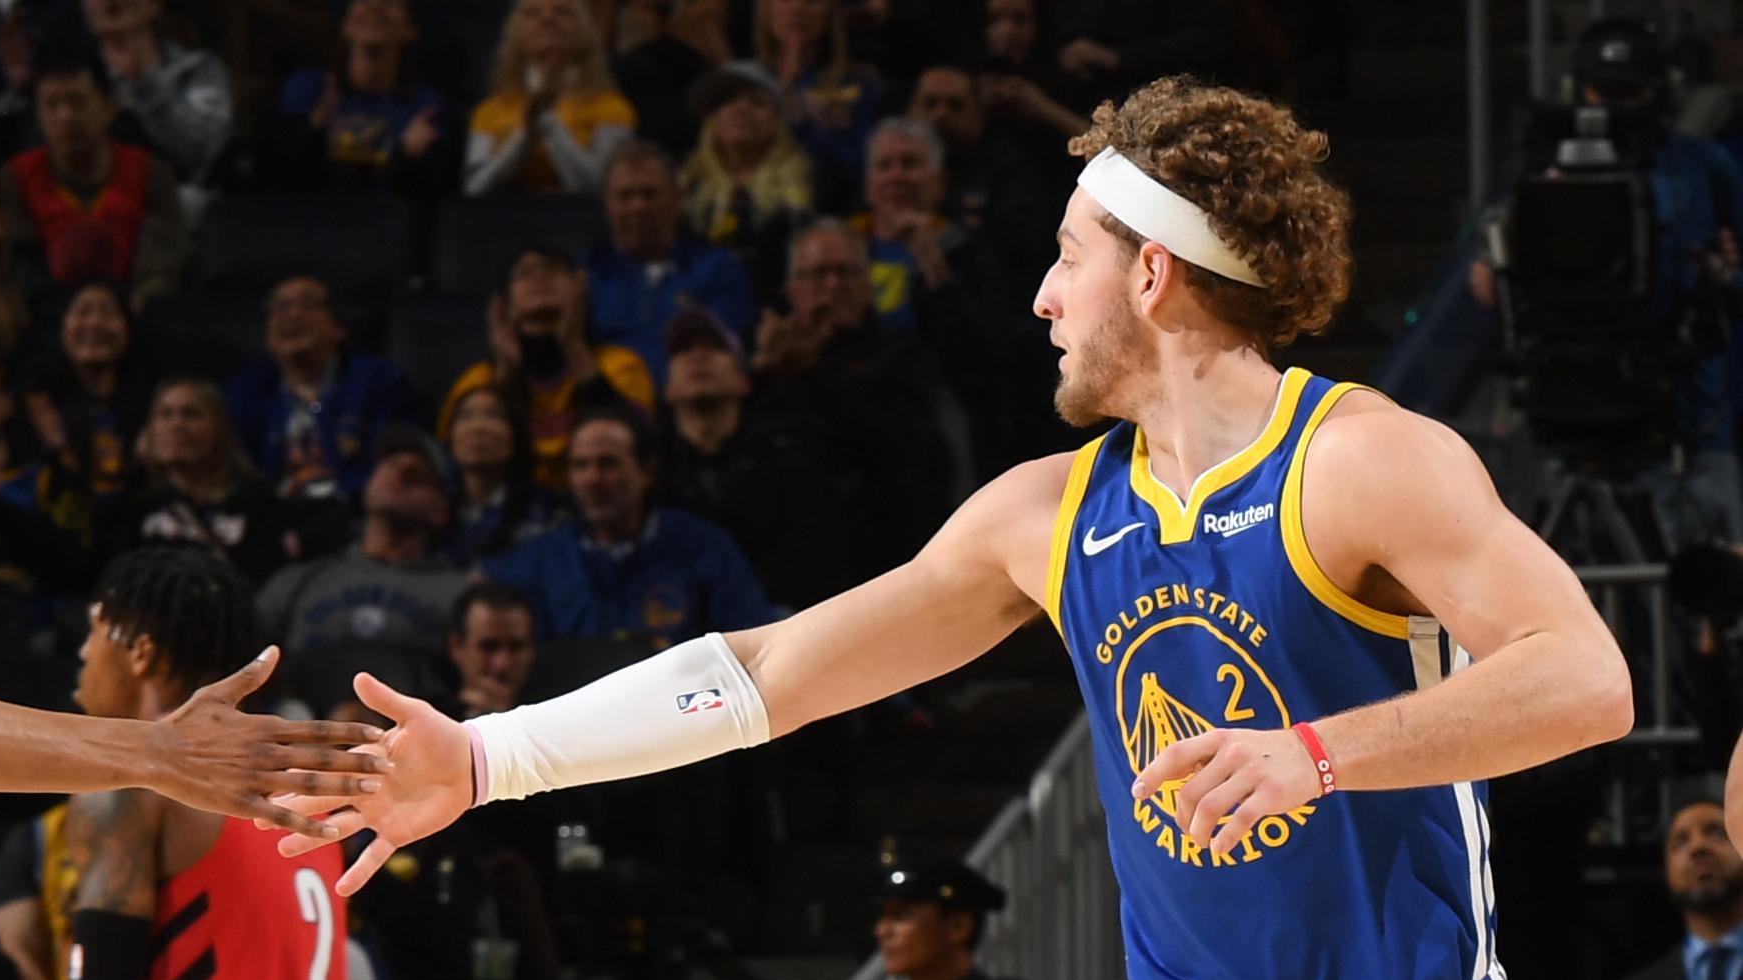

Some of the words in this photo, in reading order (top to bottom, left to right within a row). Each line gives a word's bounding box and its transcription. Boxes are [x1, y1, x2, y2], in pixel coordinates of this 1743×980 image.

[1203, 503, 1274, 534] Rakuten
[1095, 583, 1190, 664] GOLDEN
[1193, 592, 1268, 648] STATE
[1216, 663, 1256, 722] 2
